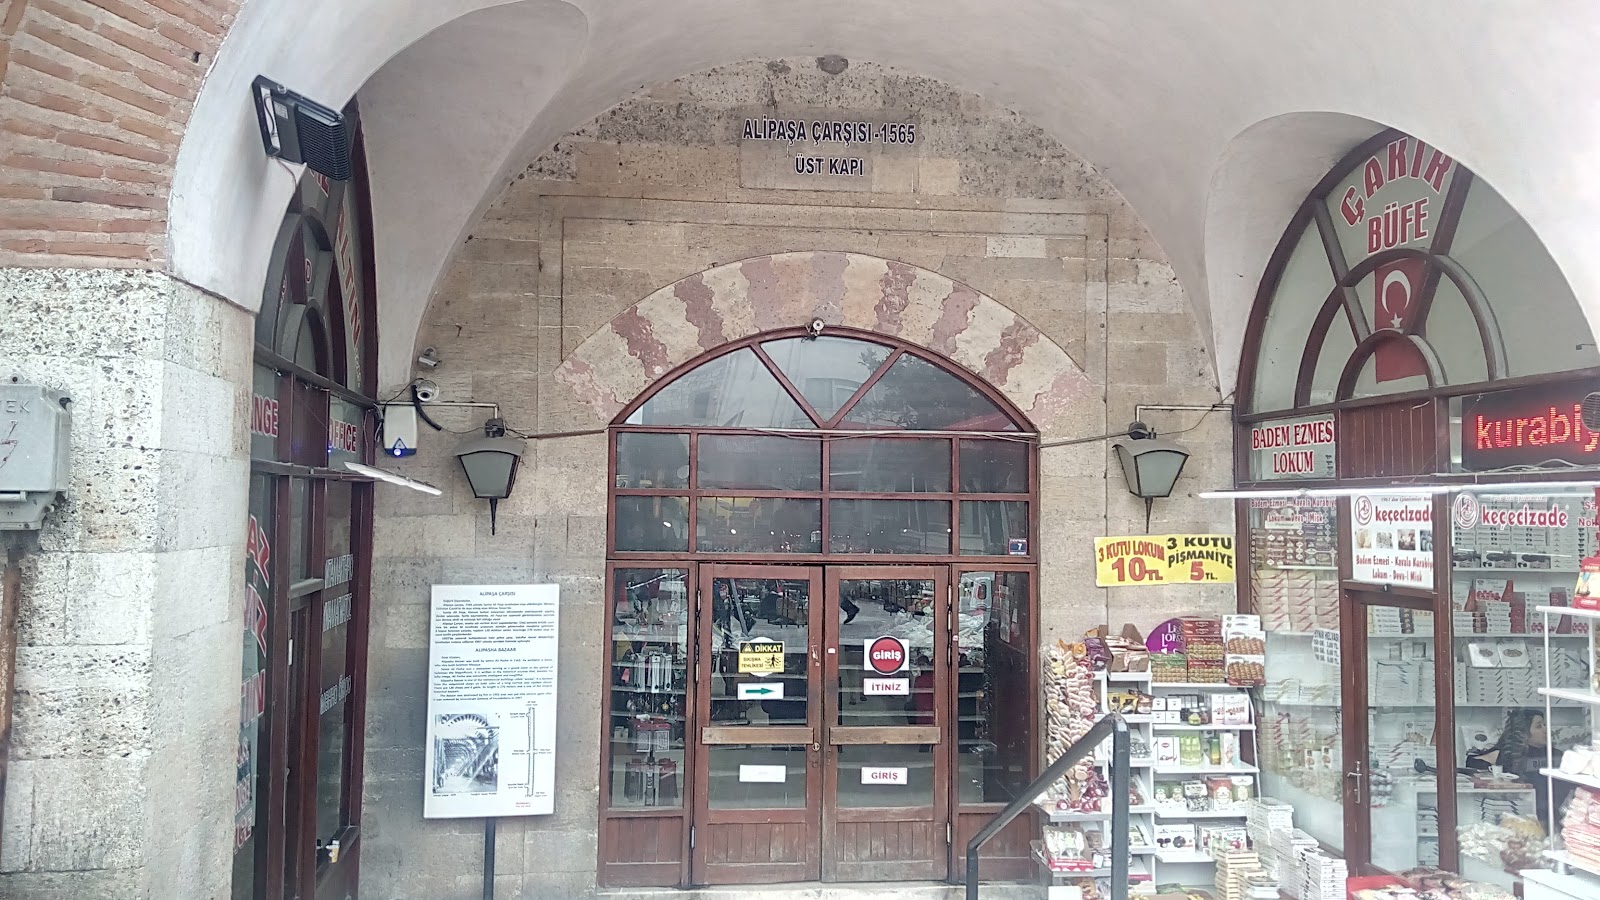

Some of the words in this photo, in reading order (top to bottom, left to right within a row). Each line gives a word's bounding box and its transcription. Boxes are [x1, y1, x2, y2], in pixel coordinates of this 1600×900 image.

[742, 115, 807, 146] ALİPAŞA
[795, 153, 825, 175] ÜST
[829, 157, 864, 176] KAPI
[1340, 136, 1453, 227] ÇAKIR
[1367, 197, 1430, 255] BÜFE
[250, 393, 278, 438] NGE
[1252, 425, 1291, 450] BADEM
[1293, 419, 1334, 446] EZMES
[1273, 450, 1315, 475] LOKUM
[1584, 500, 1597, 510] Sa
[1481, 503, 1568, 530] keçecizade
[1017, 543, 1023, 551] 7
[1098, 548, 1105, 562] 3
[1106, 540, 1131, 559] KUTU
[1133, 540, 1165, 561] LOKUM
[1167, 537, 1178, 550] 3
[1184, 537, 1232, 549] KUTU
[1168, 549, 1233, 569] PİŞMANİYE
[1190, 561, 1205, 581] 5
[754, 644, 782, 652] DİKKAT
[872, 650, 902, 661] GİRİŞ
[871, 682, 902, 691] İTİNİZ
[871, 771, 898, 781] GİRİŞ
